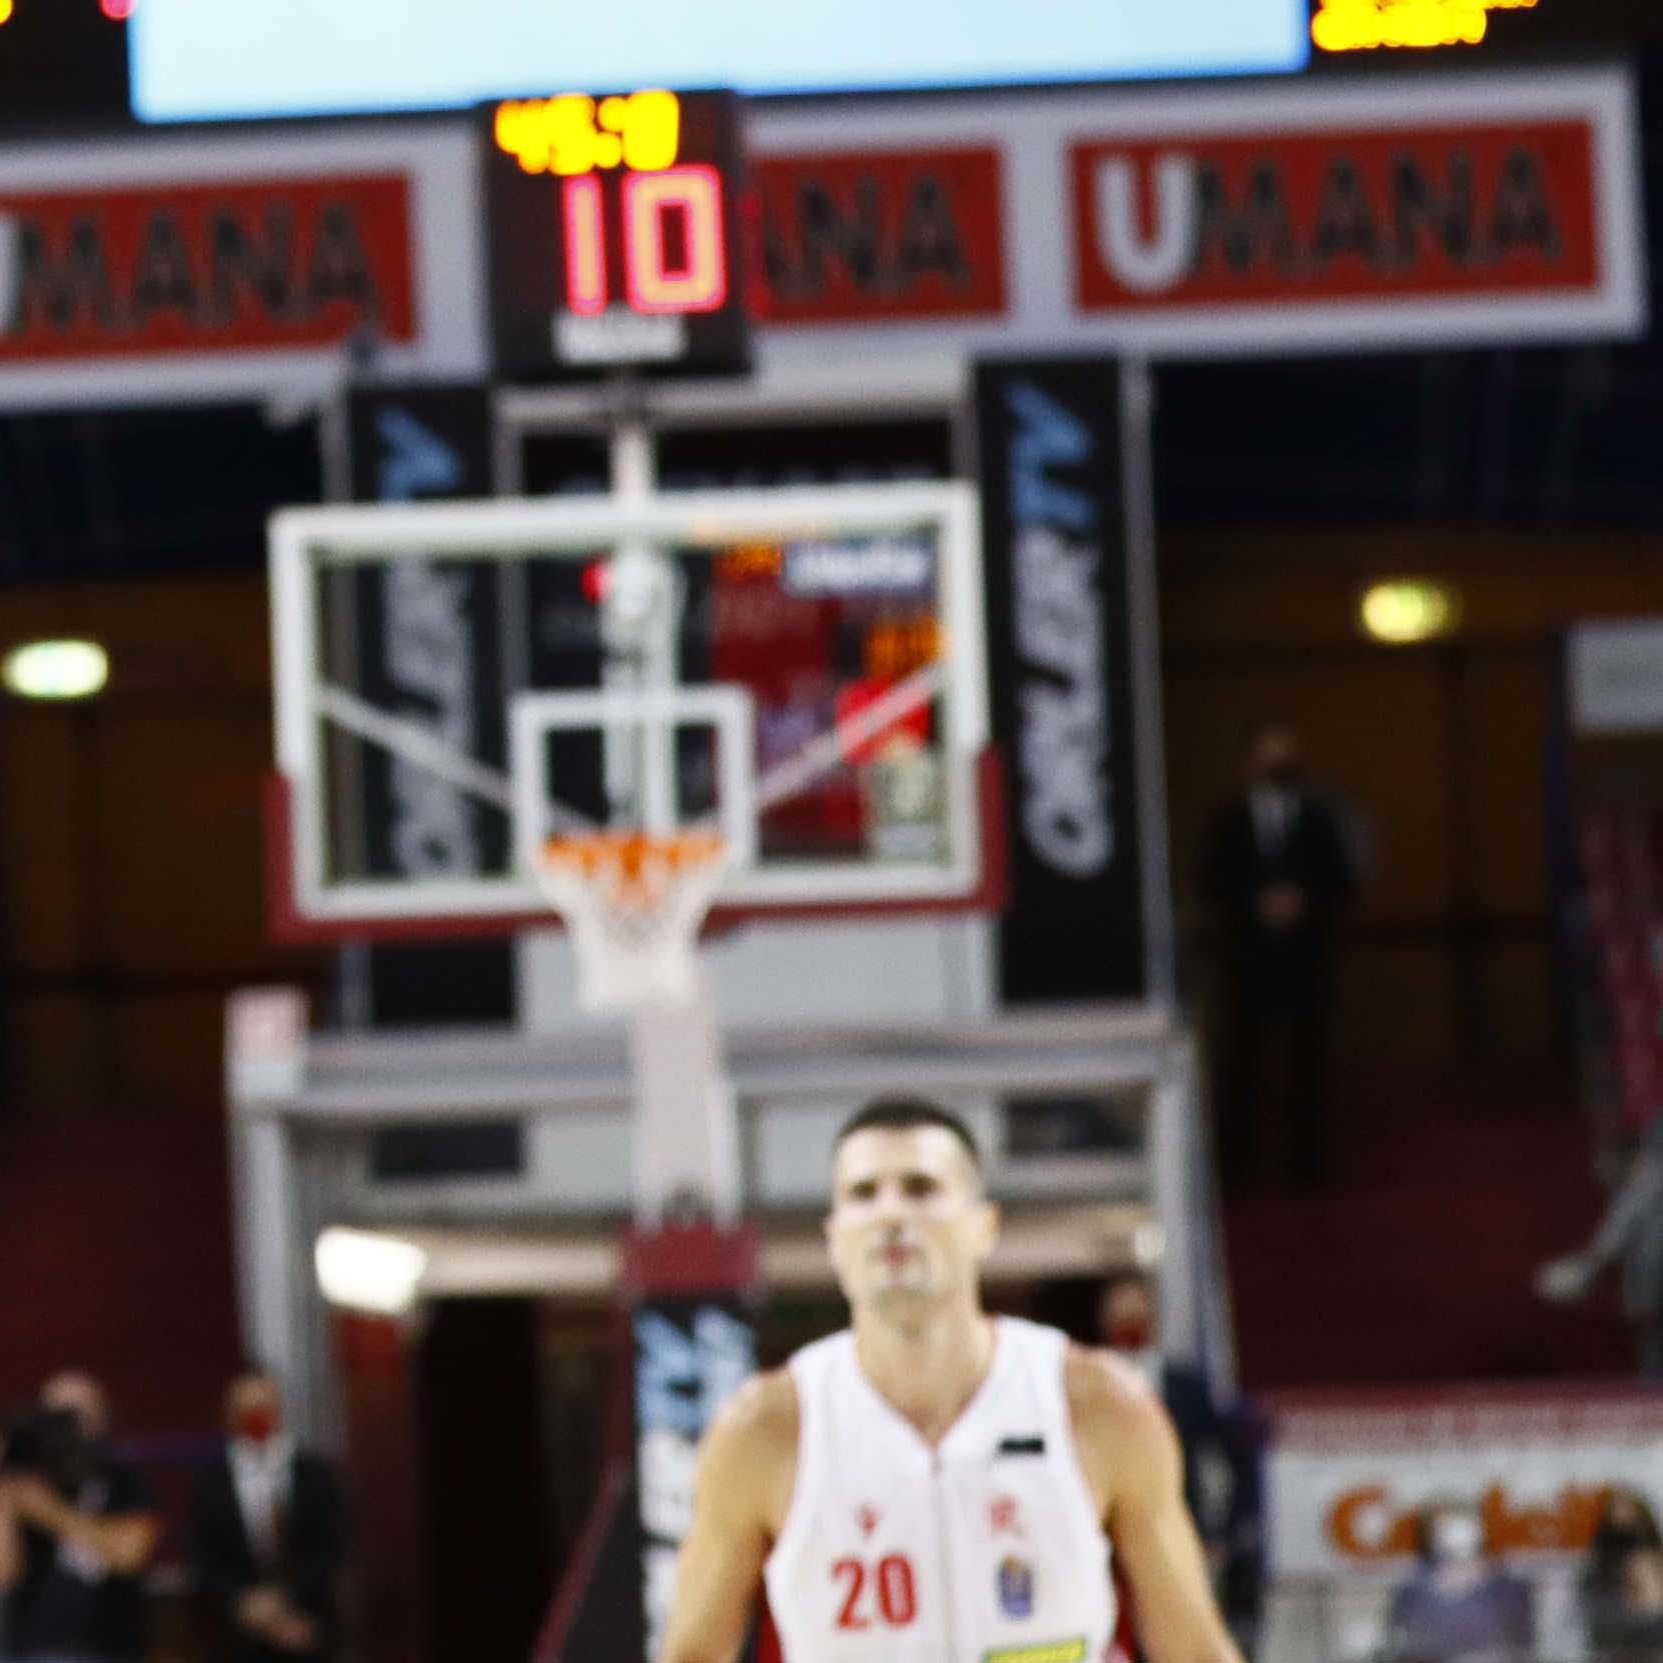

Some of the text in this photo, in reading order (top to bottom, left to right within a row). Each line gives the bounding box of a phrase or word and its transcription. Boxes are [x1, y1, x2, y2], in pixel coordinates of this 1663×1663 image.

[562, 161, 727, 317] 10
[1094, 143, 1561, 293] UMANA
[831, 1552, 916, 1630] 20
